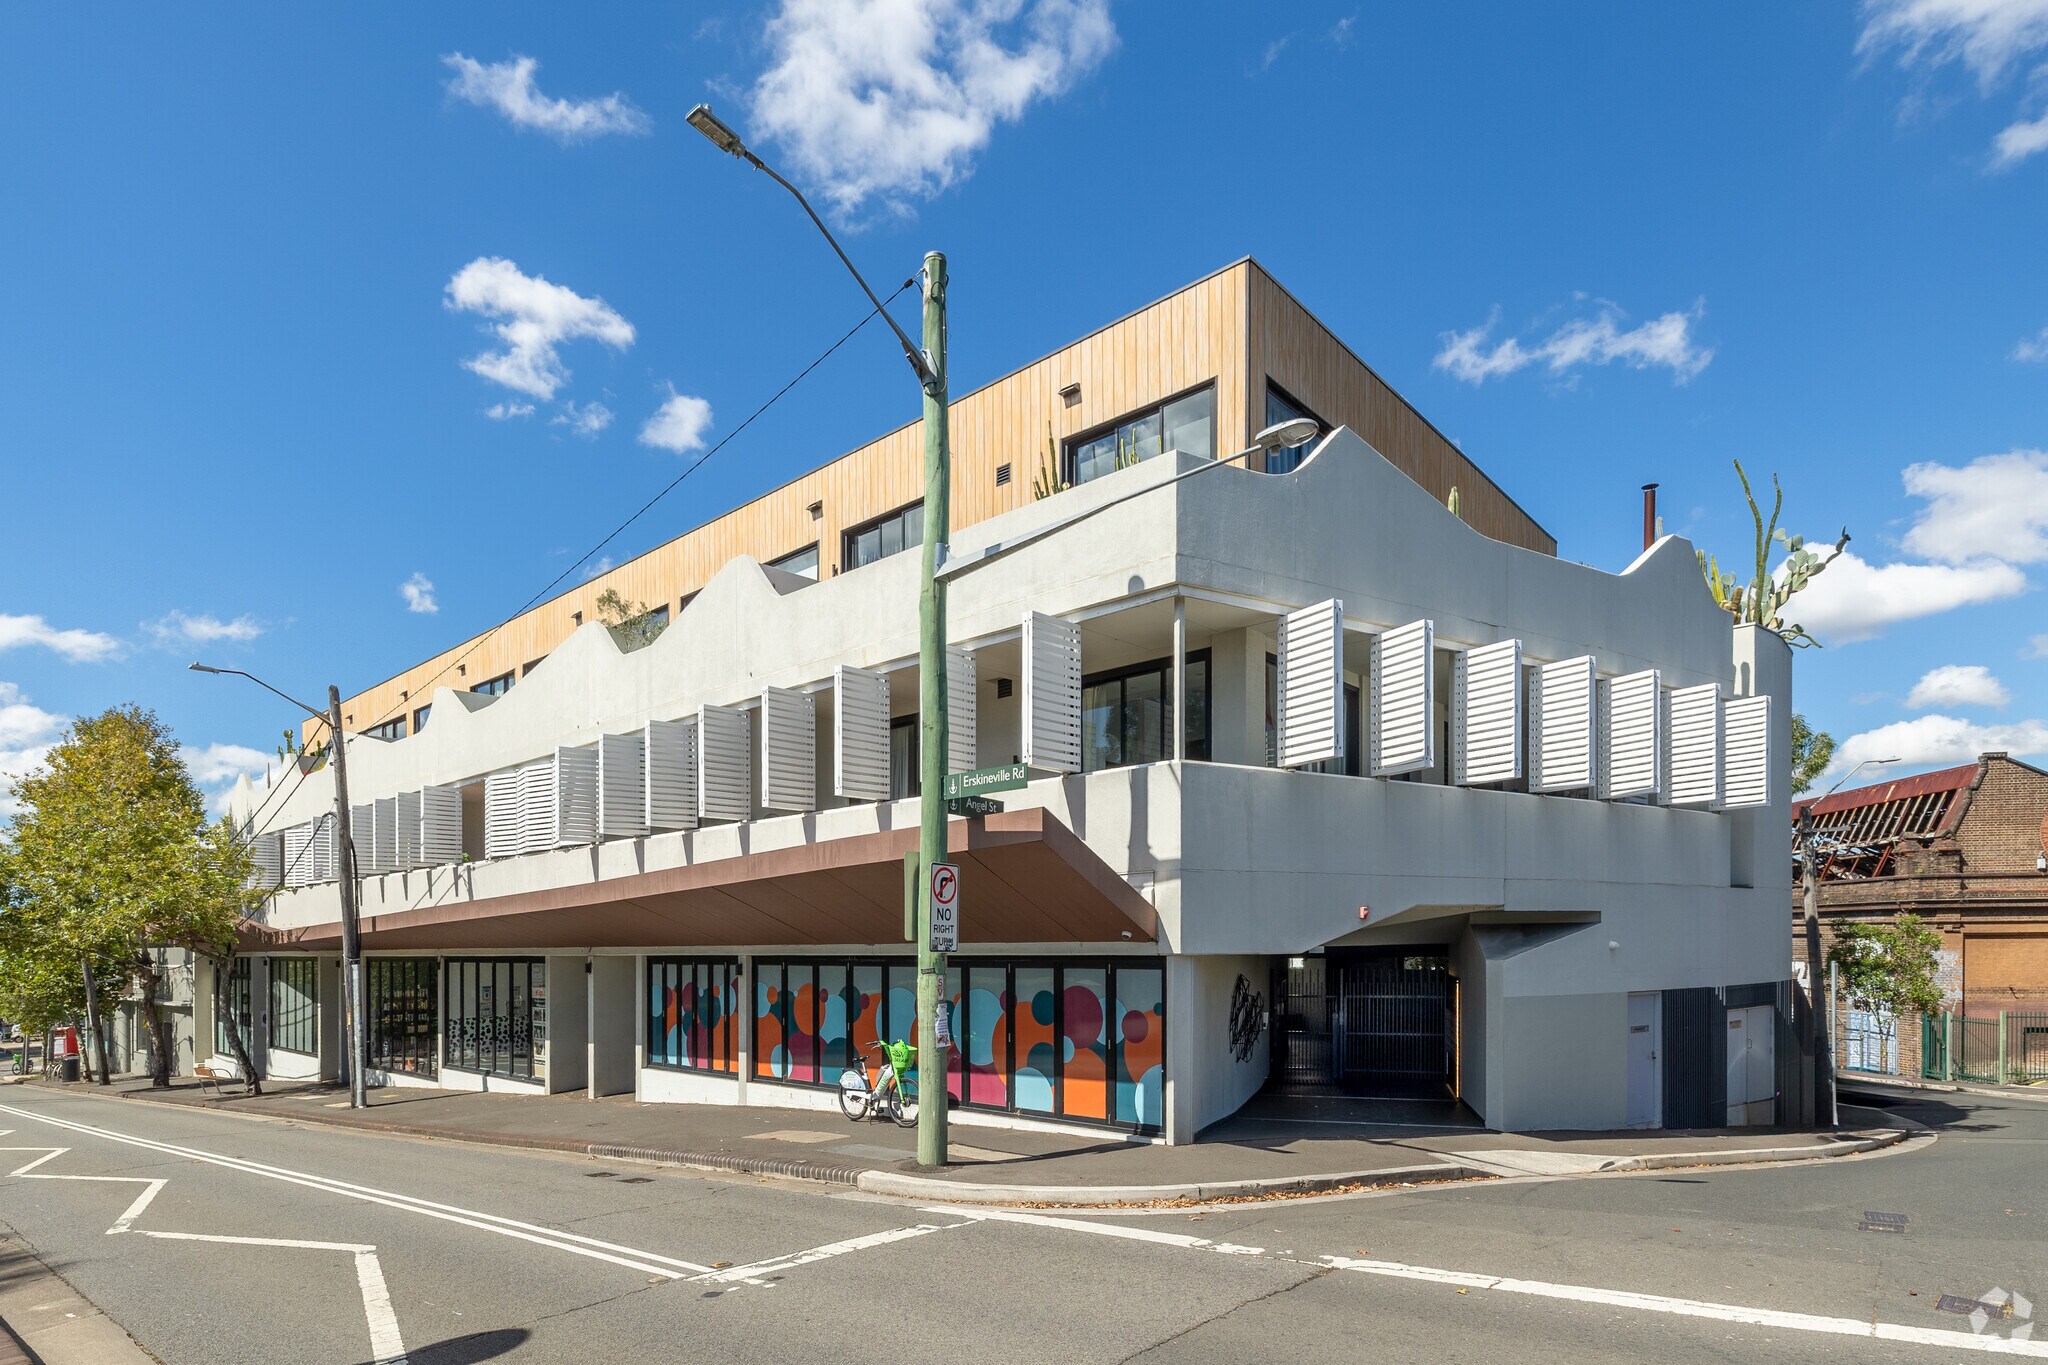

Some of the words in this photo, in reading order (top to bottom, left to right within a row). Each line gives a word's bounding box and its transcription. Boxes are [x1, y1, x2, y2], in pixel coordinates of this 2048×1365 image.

[963, 769, 1010, 787] Erskineville
[1012, 766, 1025, 780] Rd
[966, 798, 987, 813] Angel
[989, 801, 997, 813] St
[936, 908, 951, 921] NO
[933, 924, 954, 934] RIGHT
